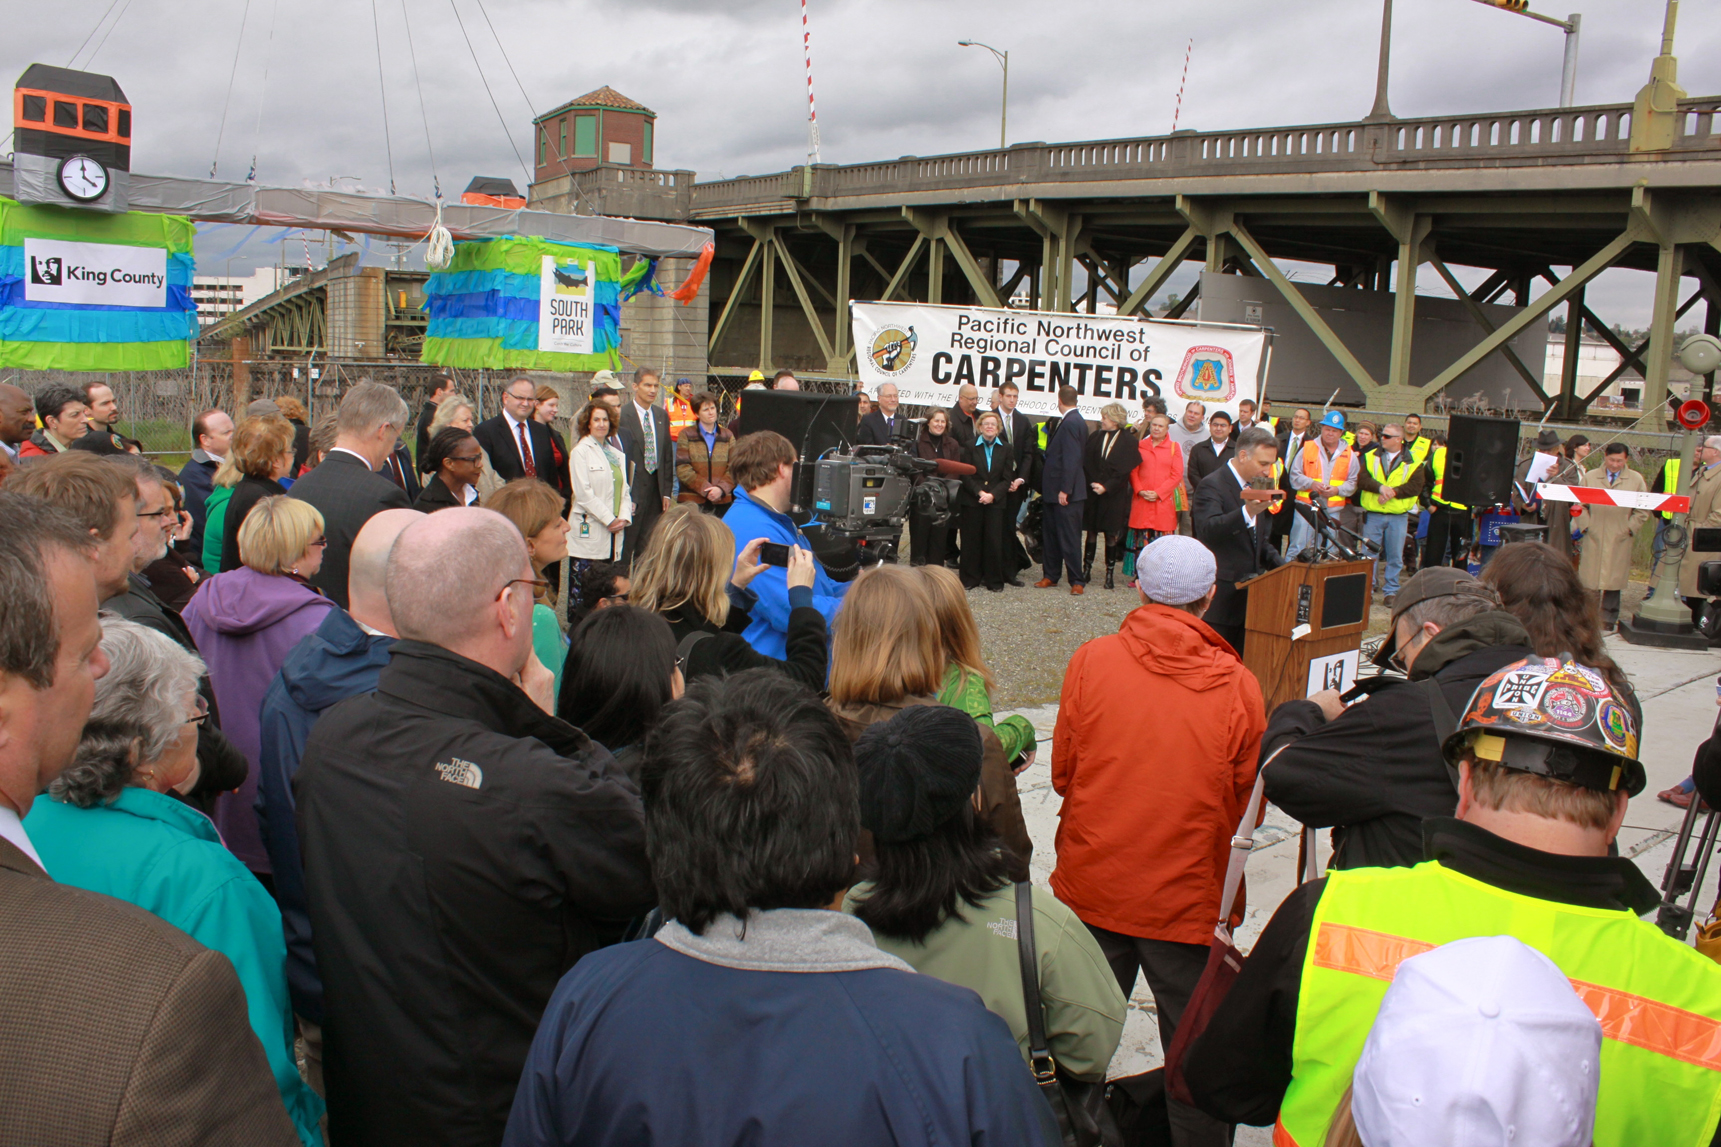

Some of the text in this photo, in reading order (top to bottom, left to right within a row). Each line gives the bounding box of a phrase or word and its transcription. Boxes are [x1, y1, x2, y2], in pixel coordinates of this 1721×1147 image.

[66, 265, 164, 289] King County
[550, 298, 588, 318] SOUTH
[552, 317, 584, 336] PARK
[958, 315, 1146, 344] Pacific Northwest
[950, 332, 1150, 362] Regional Council of
[931, 351, 1163, 400] CARPENTERS
[914, 390, 934, 400] WITH
[937, 393, 952, 402] THE
[1511, 711, 1541, 720] UNION
[435, 762, 468, 778] NORTH
[451, 757, 471, 769] THE
[440, 771, 466, 784] FACE
[986, 921, 1015, 932] NORTH
[999, 917, 1015, 926] THE
[993, 929, 1013, 938] FACE
